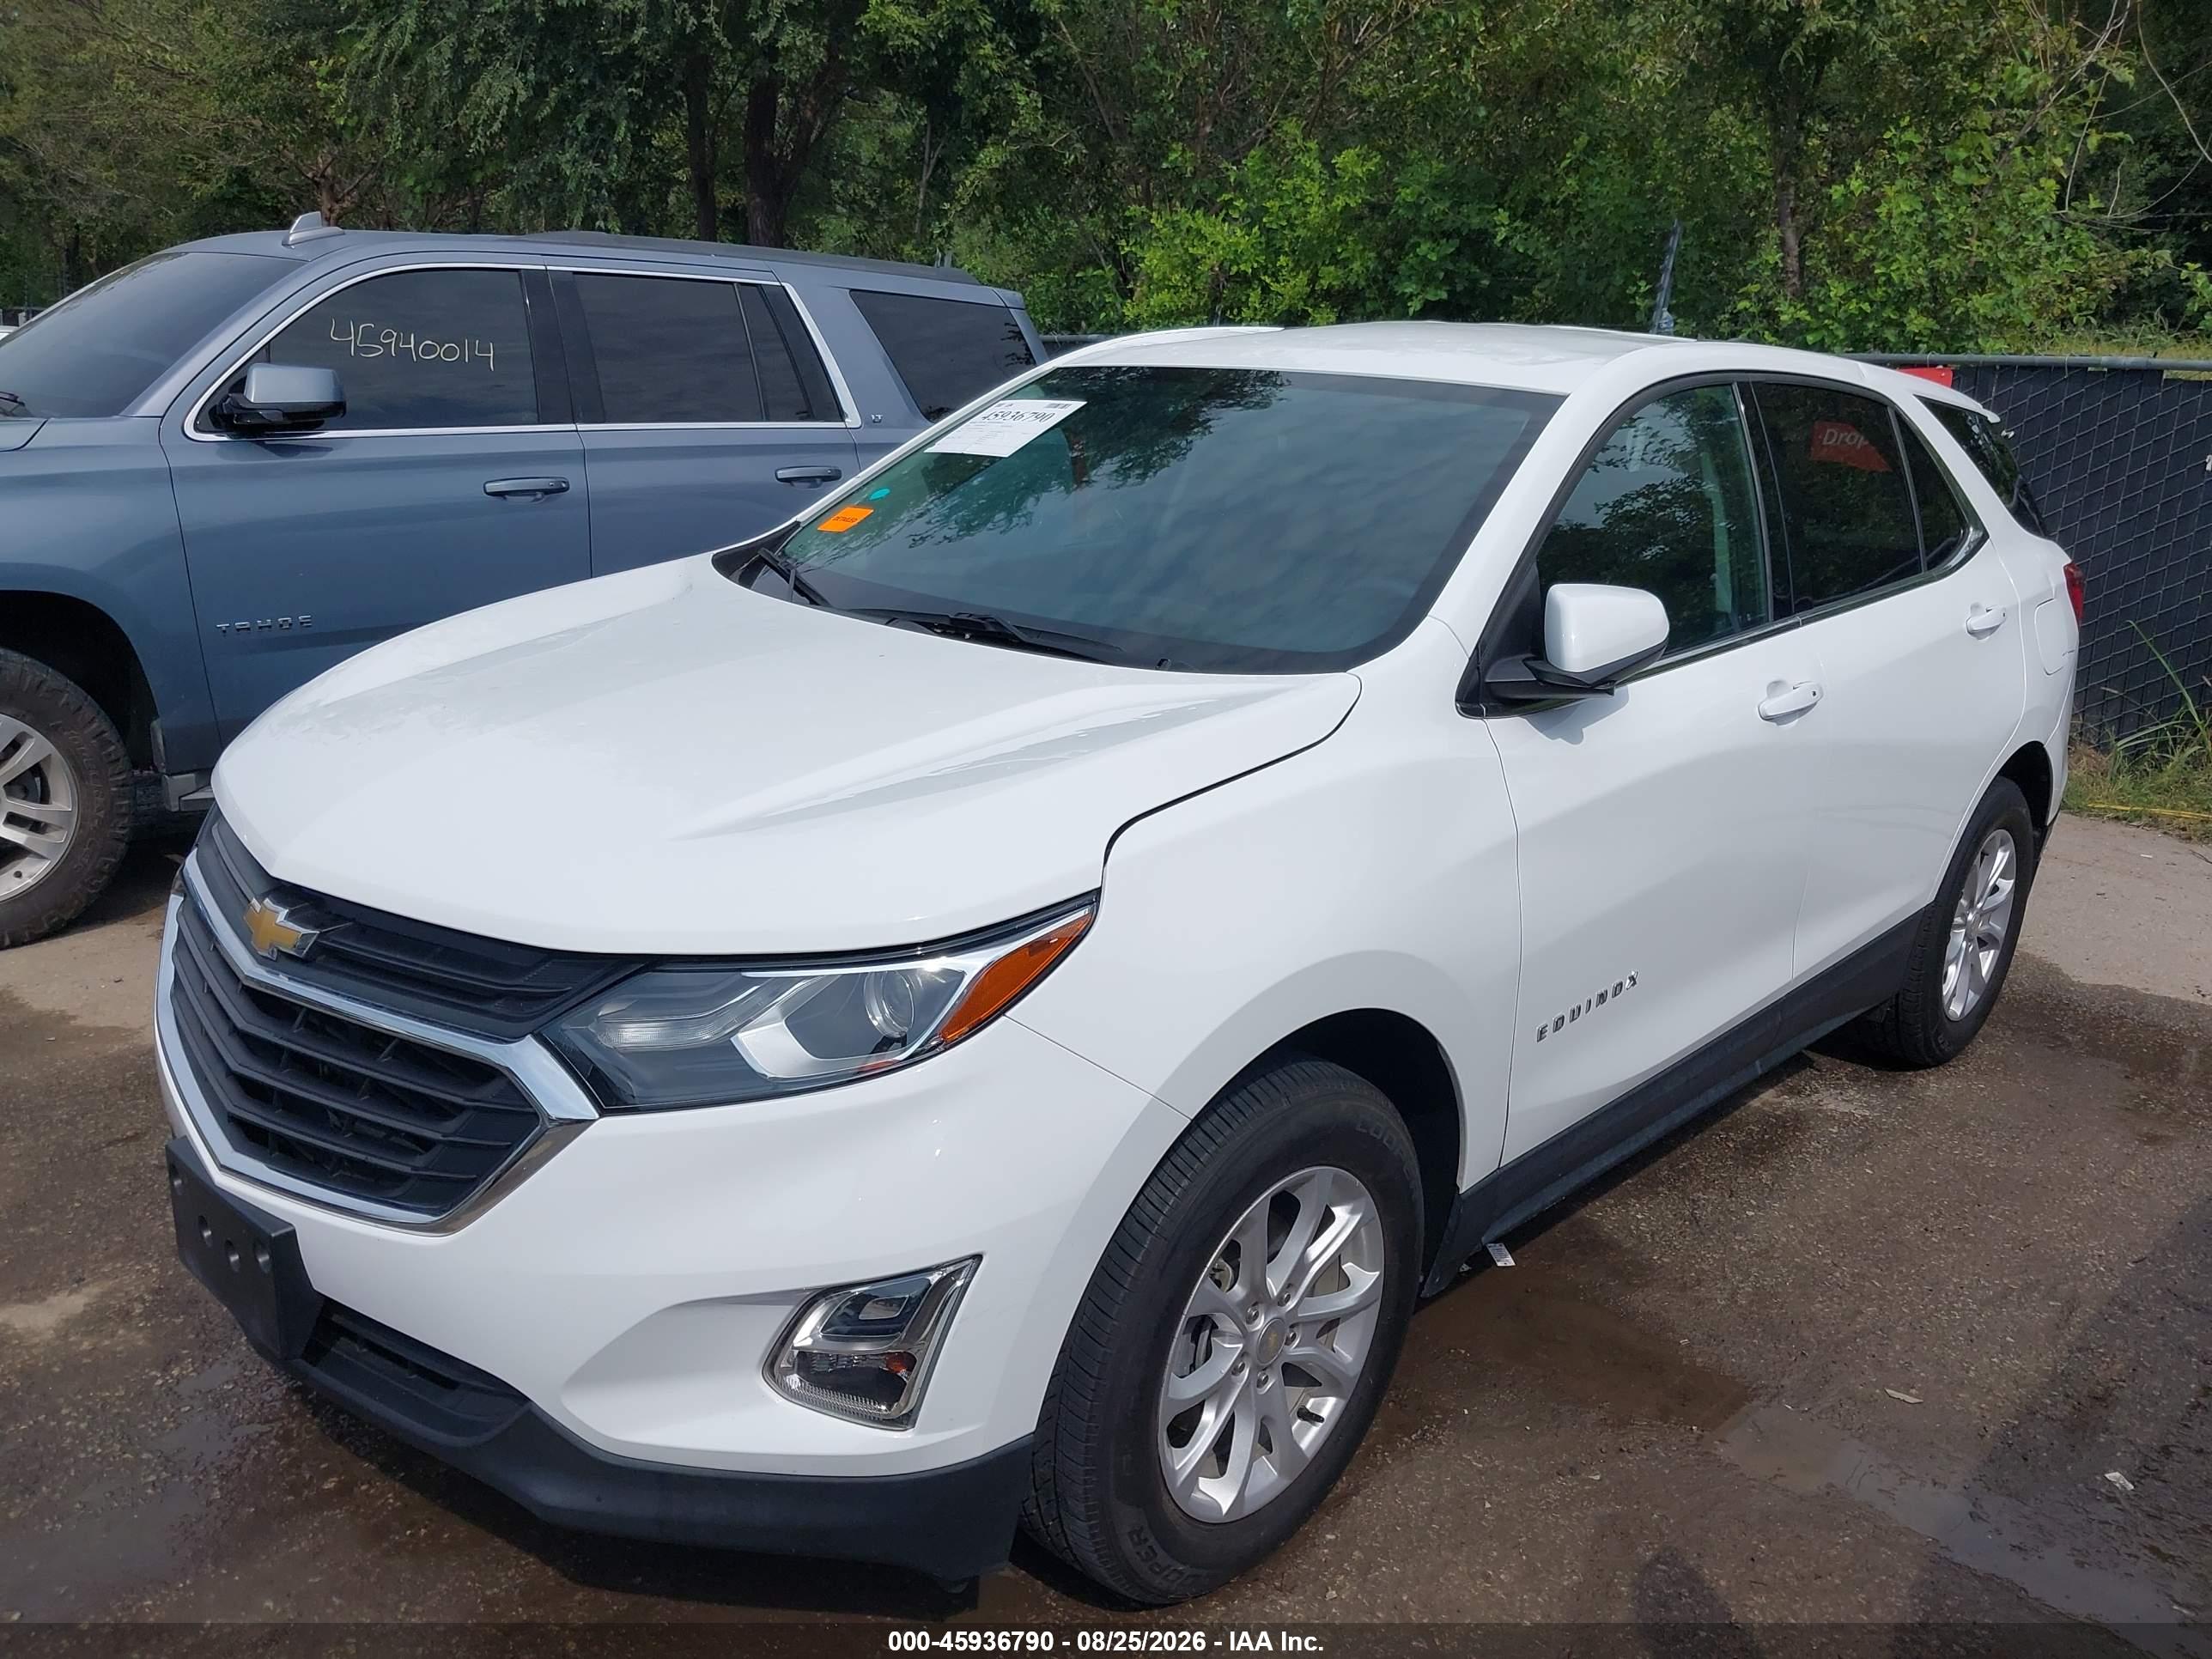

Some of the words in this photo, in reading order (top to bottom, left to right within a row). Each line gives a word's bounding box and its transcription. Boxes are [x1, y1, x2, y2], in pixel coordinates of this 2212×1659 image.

[330, 318, 495, 371] 45940014
[981, 410, 1055, 423] 45936790
[216, 615, 313, 634] TAHOE
[1536, 969, 1639, 1042] EQUINOX
